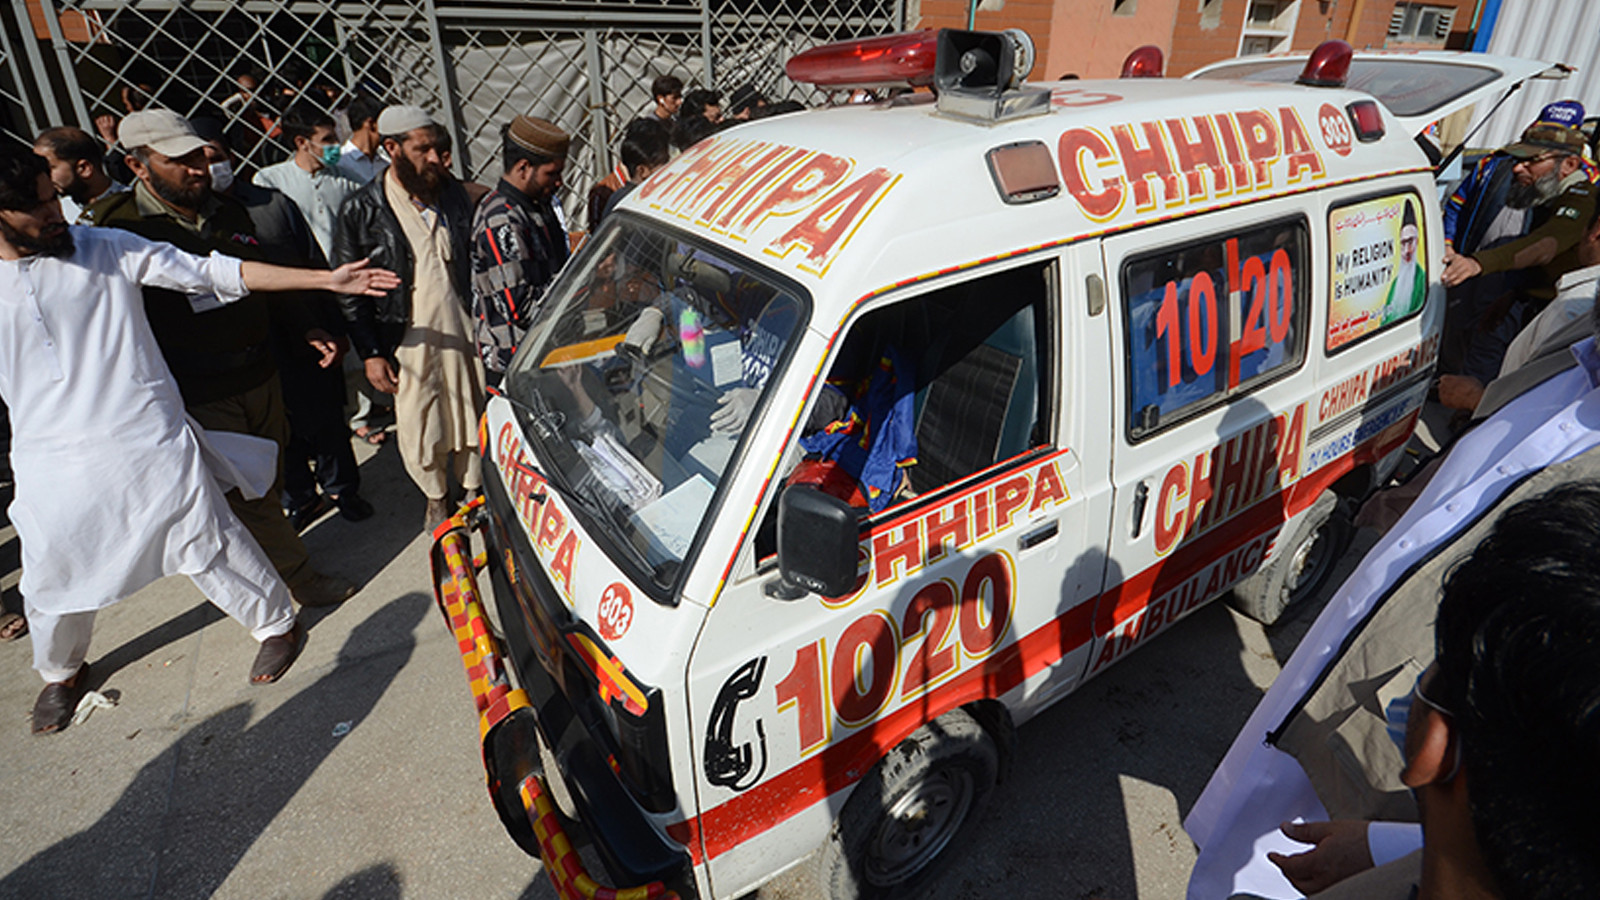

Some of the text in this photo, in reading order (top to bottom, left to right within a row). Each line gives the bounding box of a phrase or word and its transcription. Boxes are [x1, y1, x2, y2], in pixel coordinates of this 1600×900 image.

[1058, 107, 1325, 223] CHHIPA
[1321, 115, 1350, 146] 303
[639, 136, 902, 278] CHHIPA
[1352, 239, 1395, 269] RELIGION
[1344, 264, 1394, 297] HUMANITY
[1318, 369, 1369, 422] CHHIPA
[1369, 332, 1440, 396] AMBANCE
[497, 420, 582, 607] CHHIPA
[1154, 401, 1308, 557] CHHIPA
[601, 587, 632, 636] 303
[774, 548, 1017, 758] 1020
[1092, 529, 1281, 673] AMBULANCE
